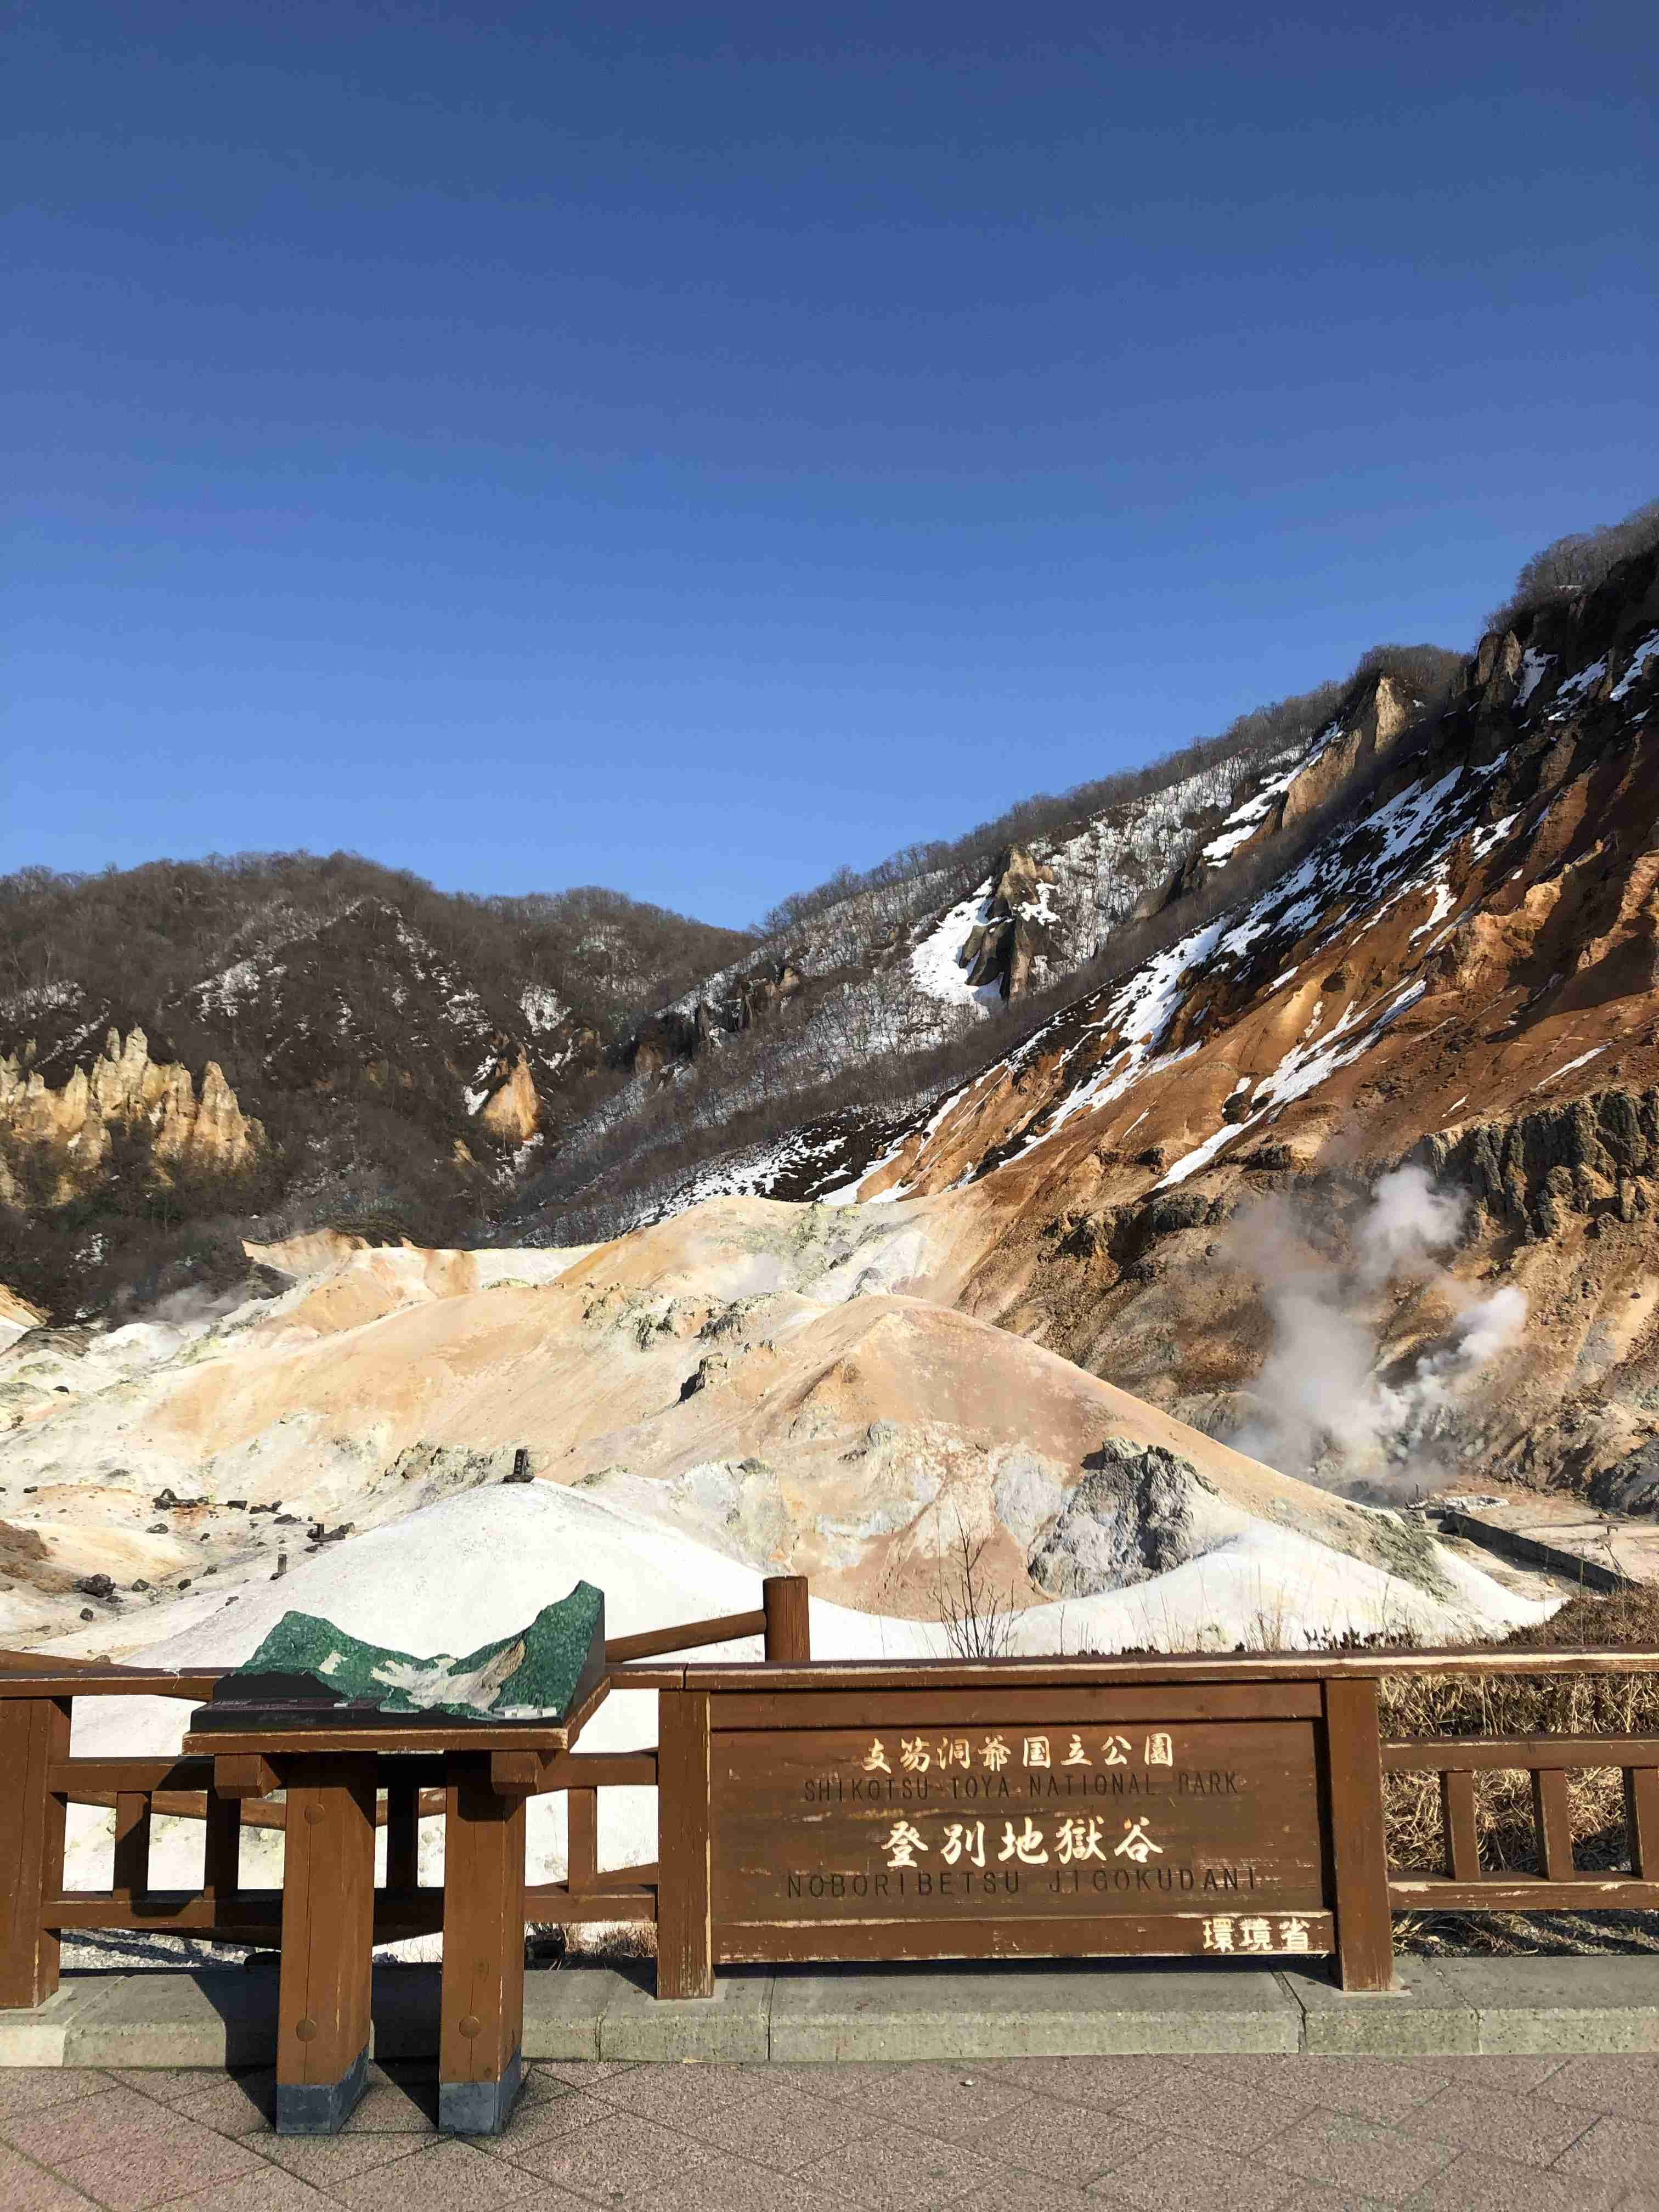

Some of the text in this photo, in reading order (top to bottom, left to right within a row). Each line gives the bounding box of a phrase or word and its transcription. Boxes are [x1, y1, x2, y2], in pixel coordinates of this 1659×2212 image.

[1029, 1773, 1156, 1798] NATIONAL
[1178, 1771, 1239, 1796] PARK
[881, 1816, 1164, 1867] 登別地獄谷
[1048, 1867, 1256, 1892] JIGOKUDANI
[1202, 1917, 1310, 1953] 環境省
